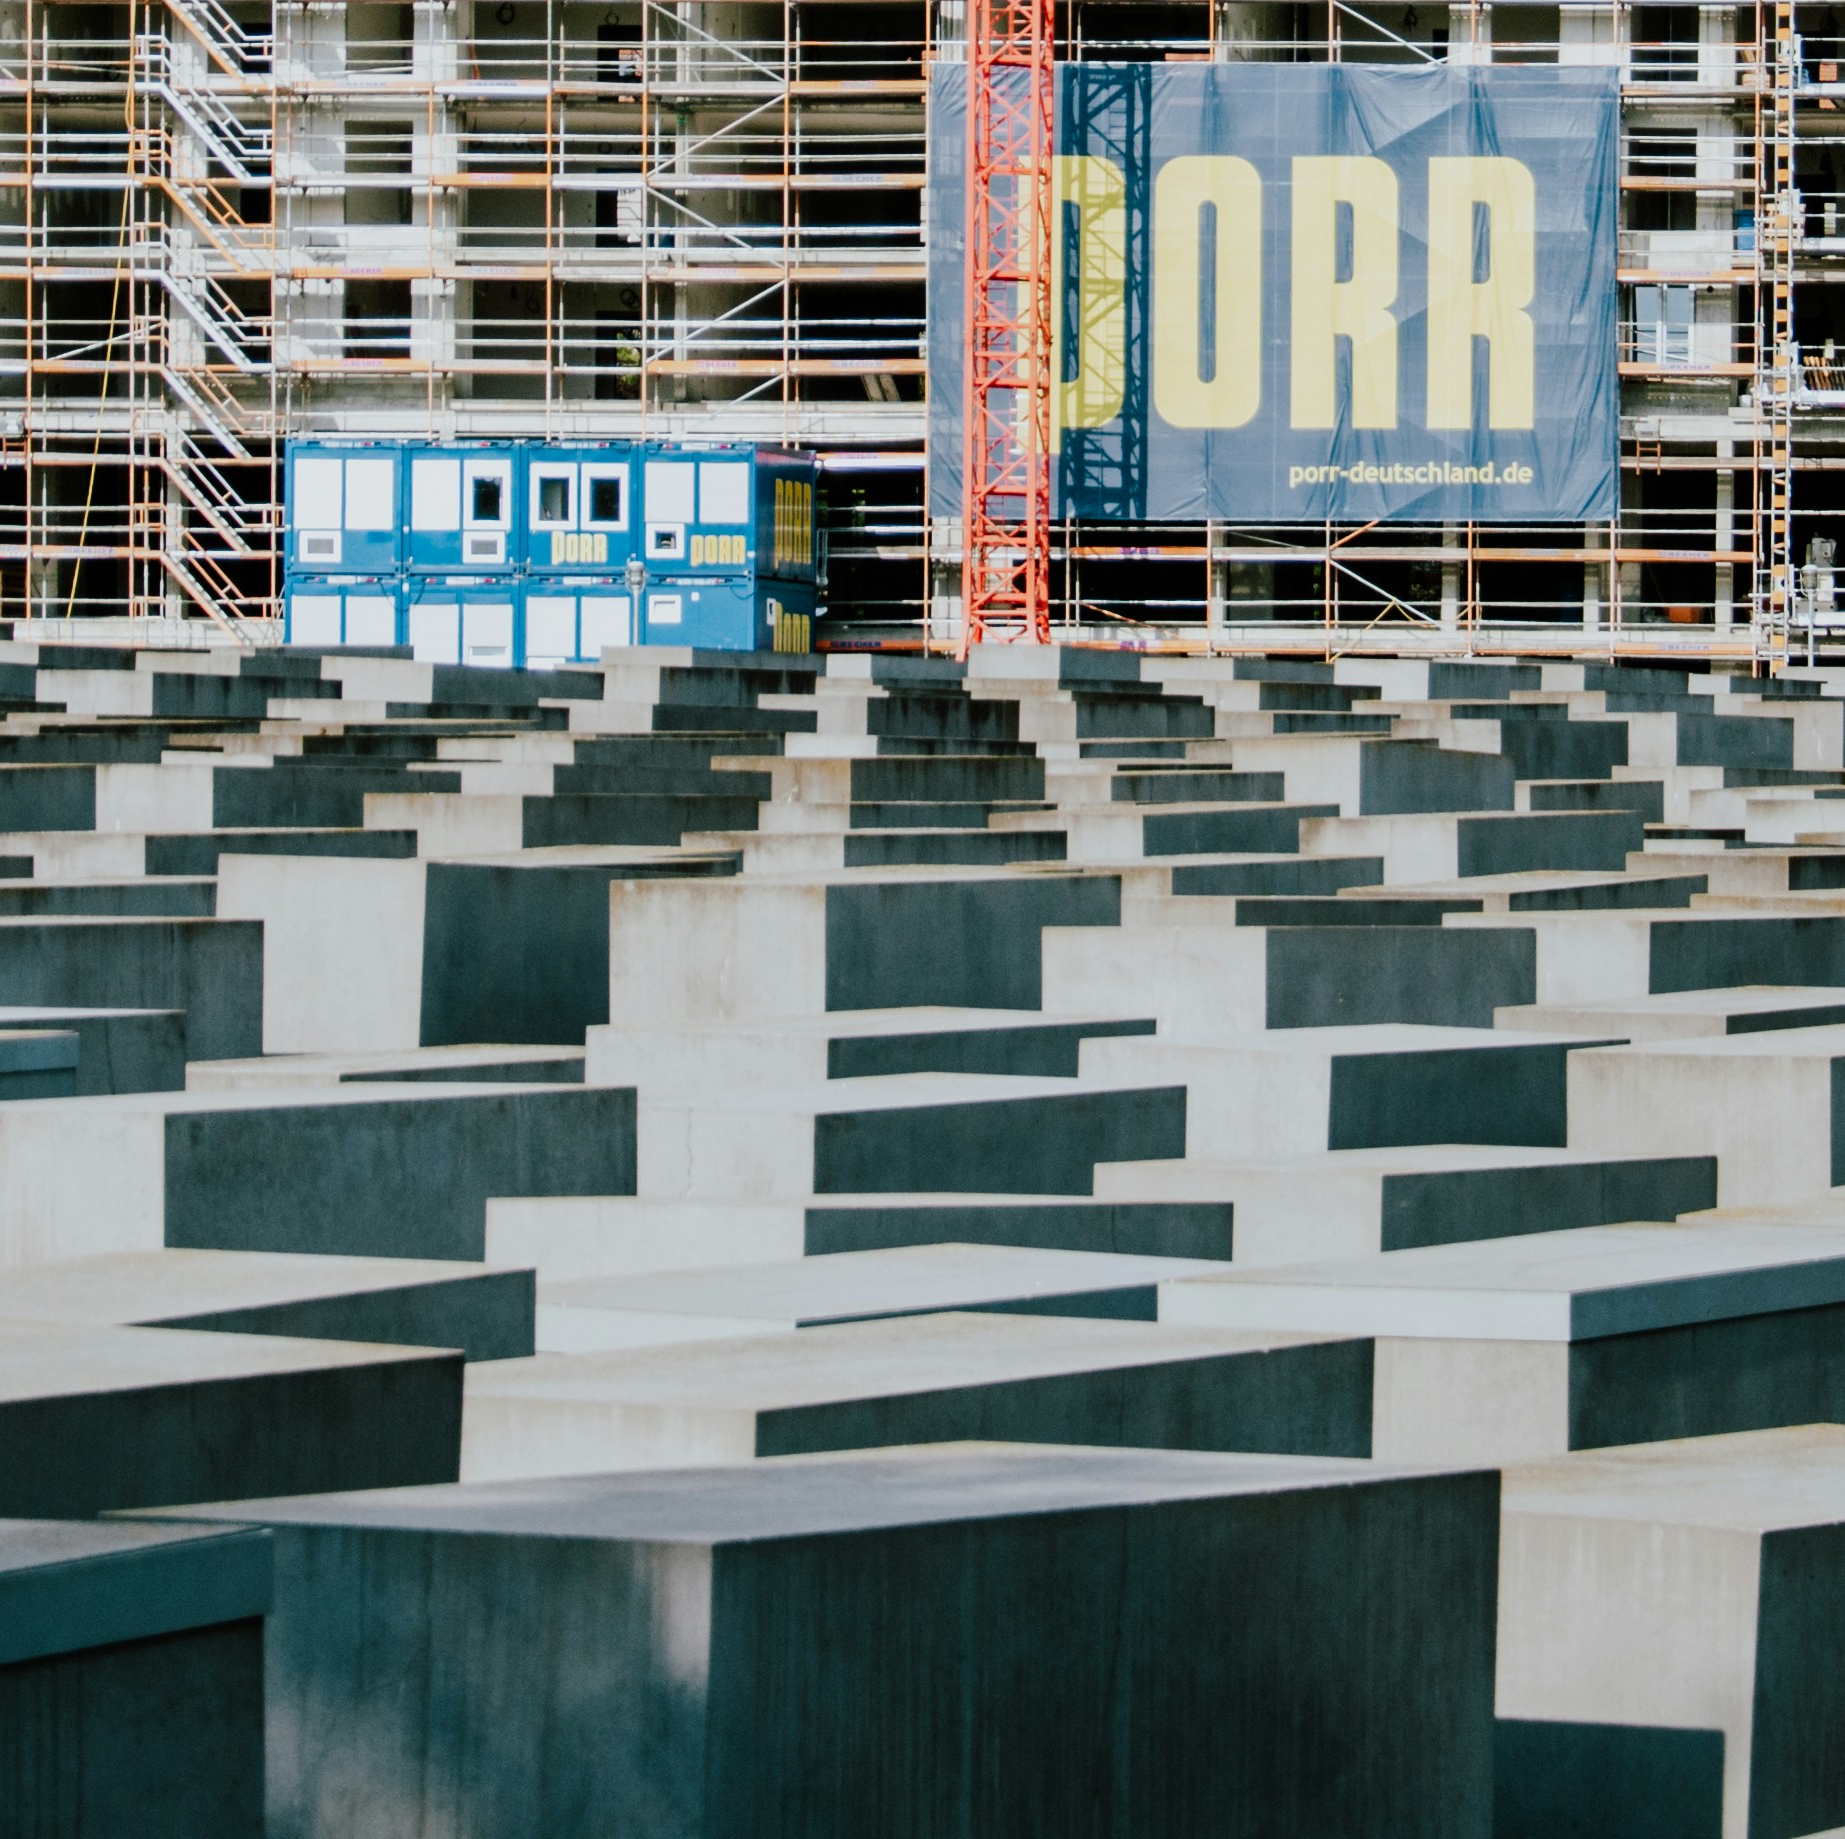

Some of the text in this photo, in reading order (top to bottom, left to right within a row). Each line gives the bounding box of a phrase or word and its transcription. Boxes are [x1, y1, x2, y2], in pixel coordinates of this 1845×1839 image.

[1017, 155, 1535, 455] PORR
[1289, 462, 1533, 488] porr-deutschland.de
[774, 478, 812, 569] PORR
[551, 530, 608, 565] PORR
[691, 534, 746, 565] PORR
